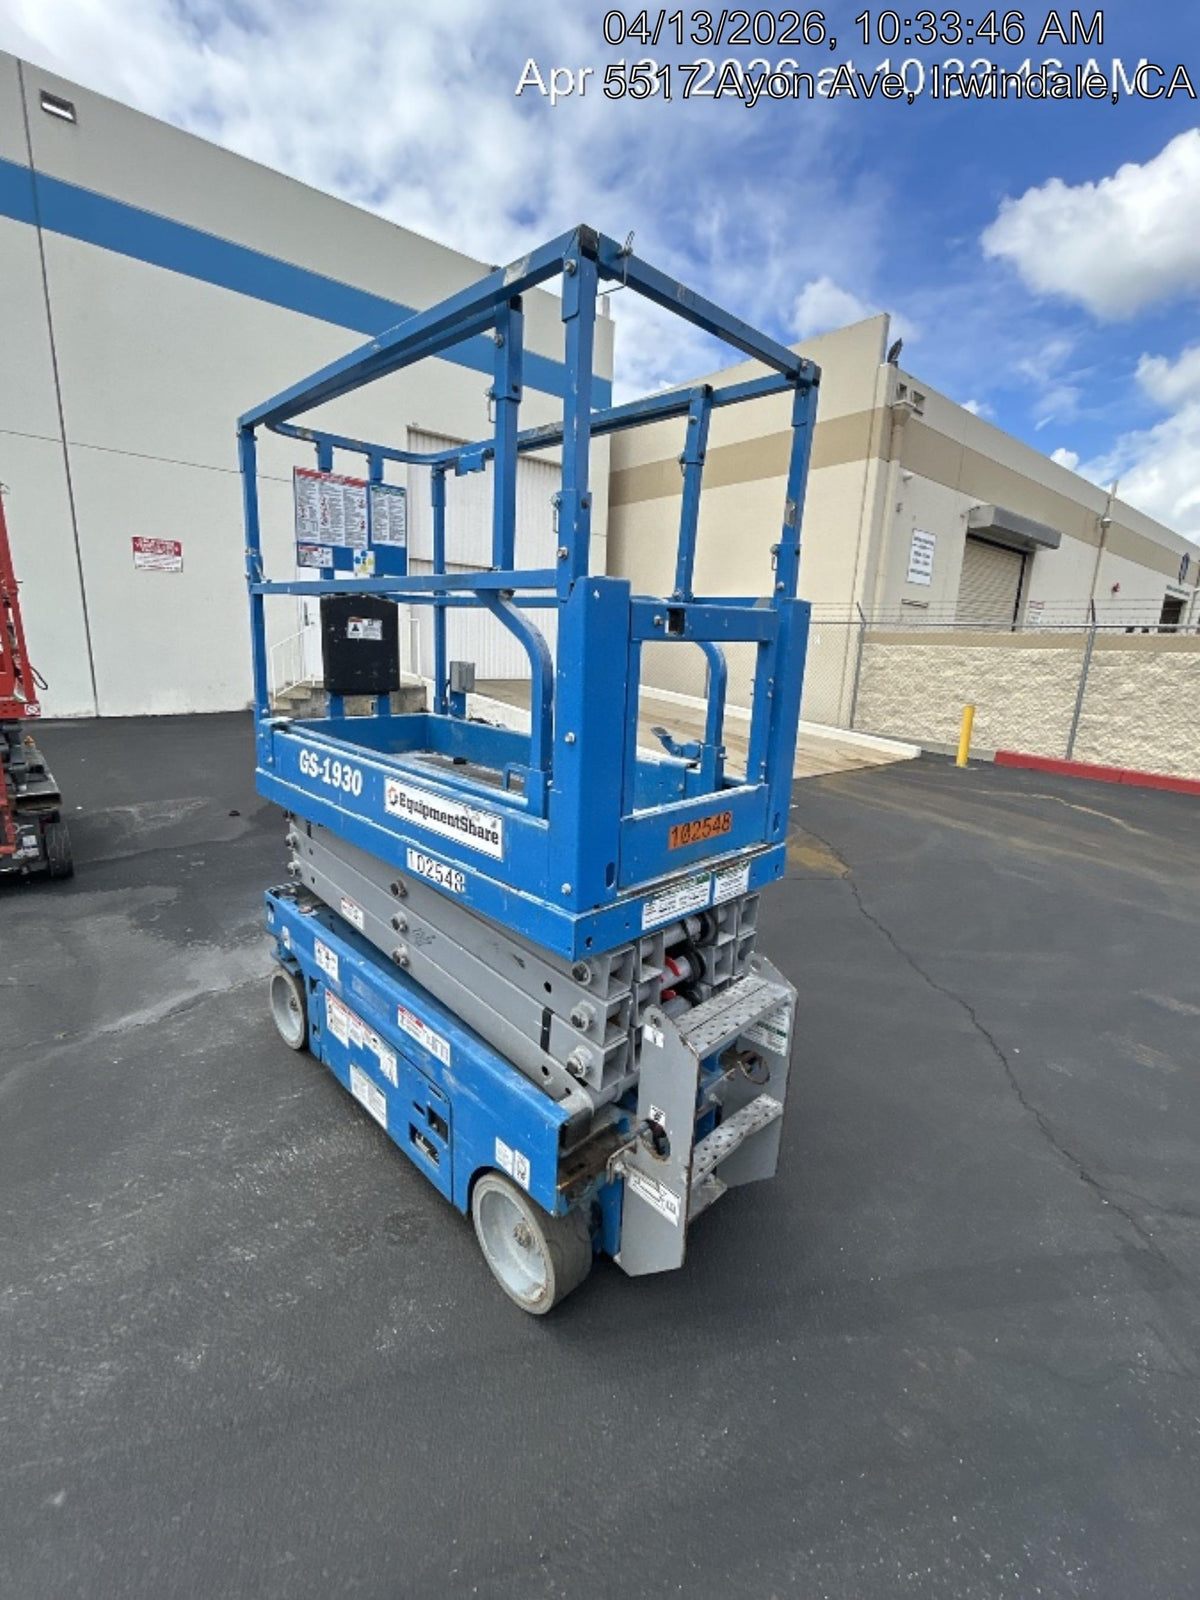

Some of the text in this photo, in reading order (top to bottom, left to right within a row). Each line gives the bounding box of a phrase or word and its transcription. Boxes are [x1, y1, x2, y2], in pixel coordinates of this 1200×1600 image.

[300, 750, 363, 797] GS-1930
[399, 793, 500, 845] EquipmentShare
[671, 811, 731, 848] 102548
